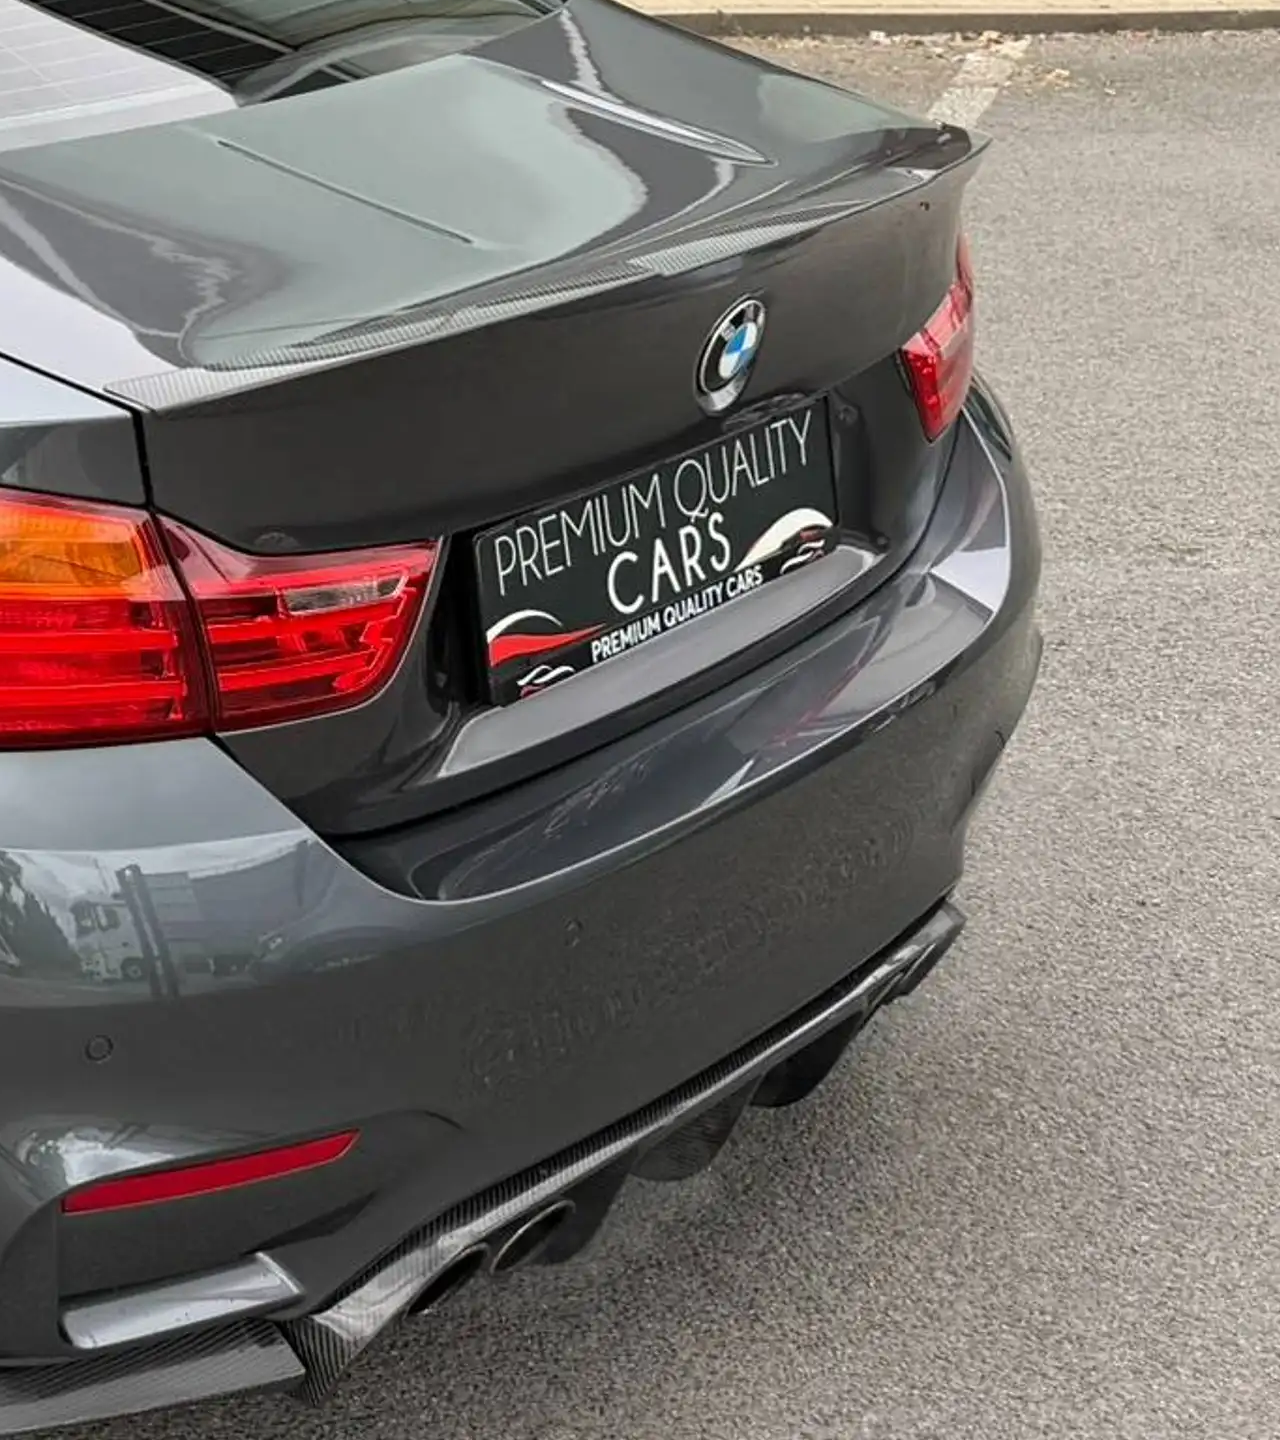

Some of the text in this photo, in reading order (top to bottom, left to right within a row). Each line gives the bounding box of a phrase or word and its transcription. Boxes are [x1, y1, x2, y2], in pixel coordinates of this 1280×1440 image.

[493, 409, 812, 597] PREMIUM QUALITY
[591, 564, 764, 663] PREMIUM QUALITY CARS
[606, 511, 732, 615] CARS
